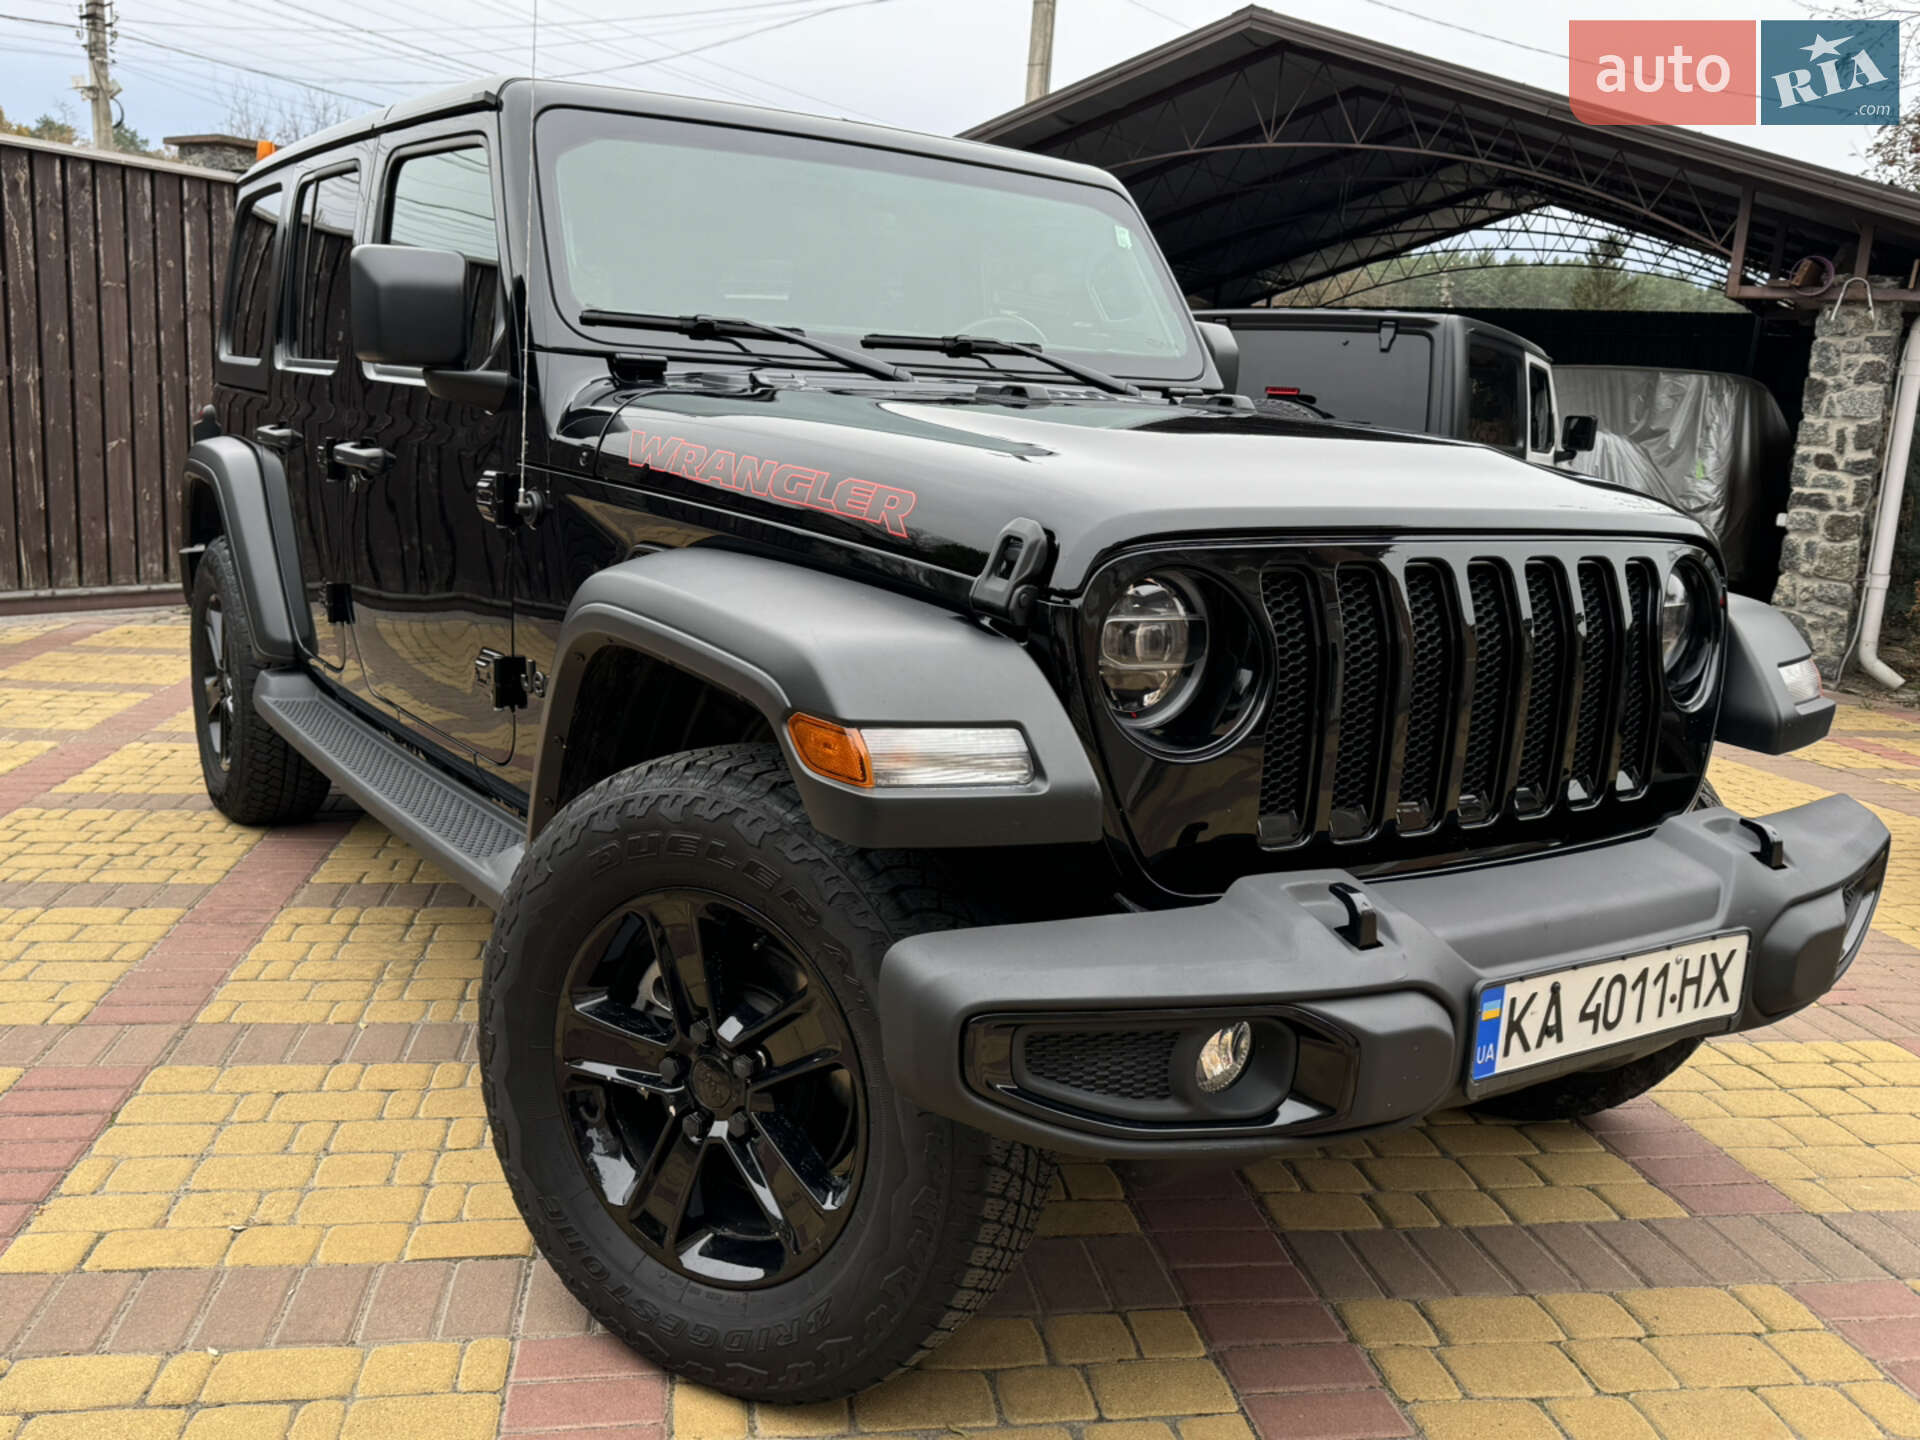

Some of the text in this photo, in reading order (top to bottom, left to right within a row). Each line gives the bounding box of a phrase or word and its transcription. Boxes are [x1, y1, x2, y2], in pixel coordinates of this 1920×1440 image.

[628, 430, 917, 539] WRANGLER
[586, 831, 822, 929] DUELER
[1476, 1043, 1496, 1065] UA
[1502, 948, 1737, 1058] KA 4011 HX
[536, 1195, 833, 1352] BRIDGESTONE
